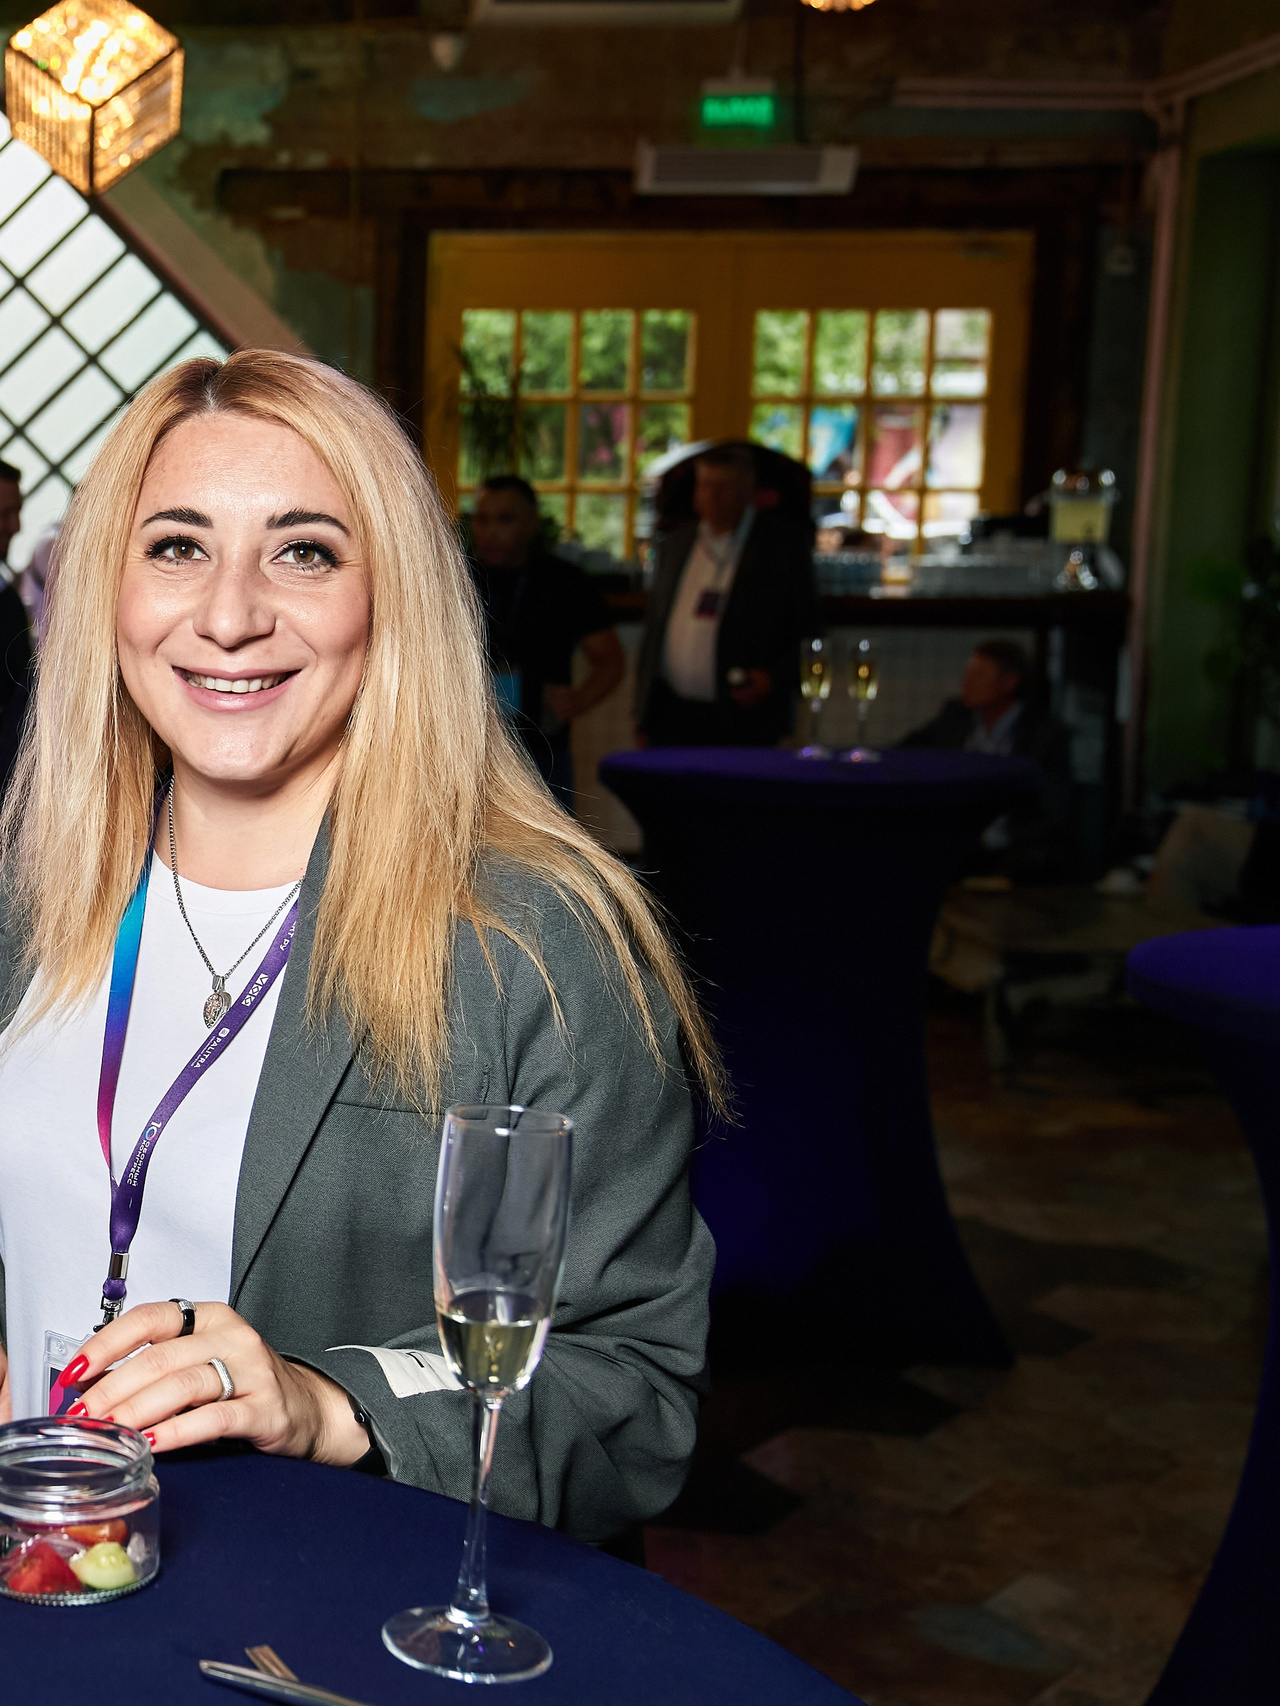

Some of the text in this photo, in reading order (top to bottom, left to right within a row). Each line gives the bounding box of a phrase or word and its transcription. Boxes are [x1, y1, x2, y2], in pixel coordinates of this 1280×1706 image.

[193, 1037, 221, 1069] PALITRA
[145, 1121, 162, 1140] 10
[126, 1140, 147, 1185] КОНГРЕСС
